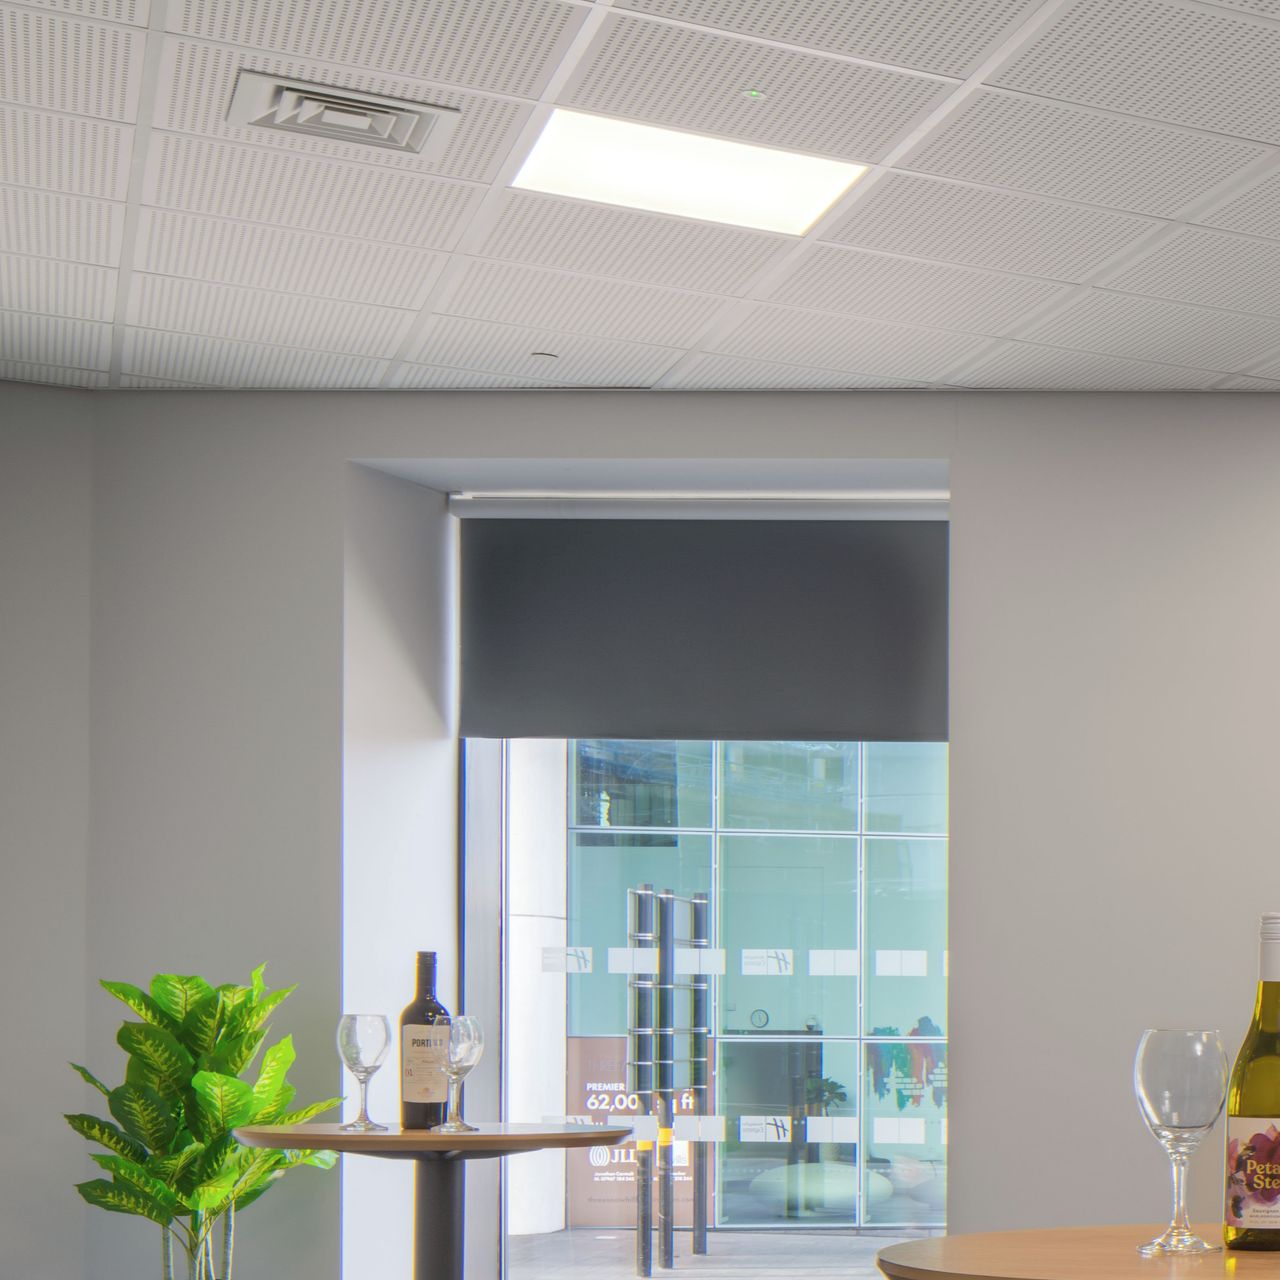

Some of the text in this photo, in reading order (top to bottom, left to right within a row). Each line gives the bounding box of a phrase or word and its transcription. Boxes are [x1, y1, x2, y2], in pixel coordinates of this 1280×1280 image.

[412, 1038, 444, 1048] PORTIO
[586, 1082, 625, 1092] PREMIER
[586, 1094, 638, 1112] 62,00
